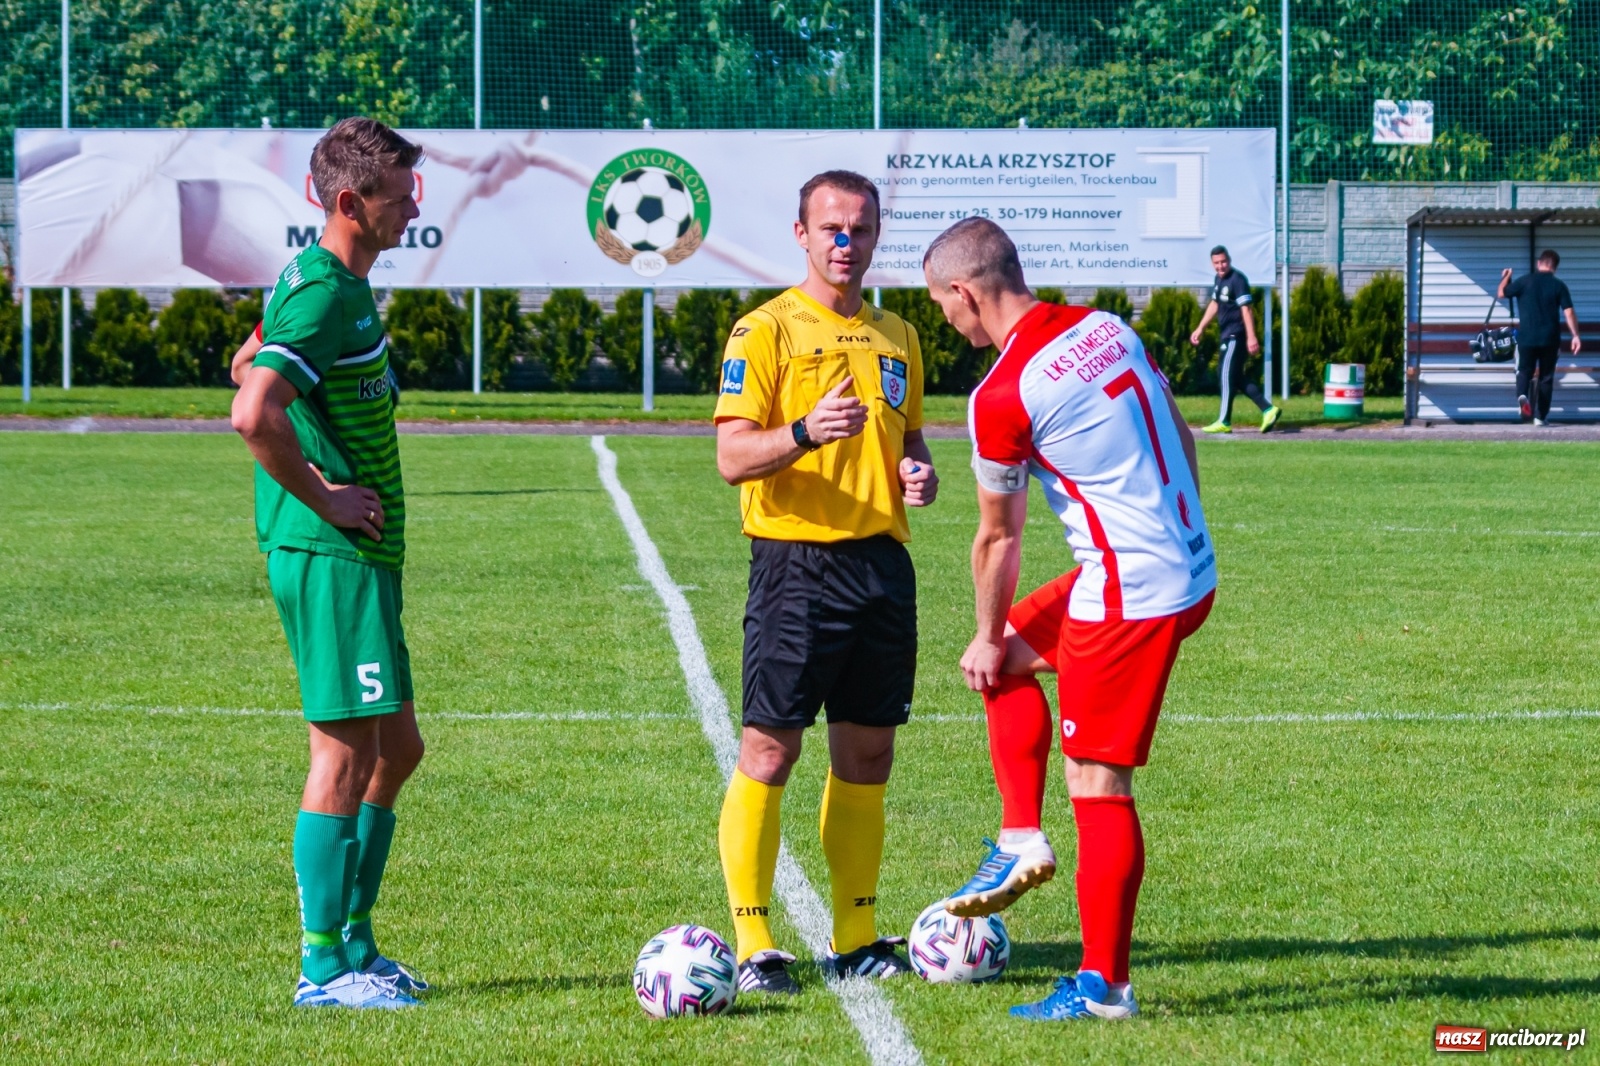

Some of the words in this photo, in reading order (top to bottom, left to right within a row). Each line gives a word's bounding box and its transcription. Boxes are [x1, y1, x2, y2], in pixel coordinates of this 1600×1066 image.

[886, 153, 993, 169] KRZYKAŁA
[998, 153, 1117, 169] KRZYSZTOF
[591, 169, 616, 203] LKS
[894, 177, 917, 186] von
[921, 175, 995, 189] genormten
[998, 174, 1077, 188] Fertigteilen,
[1081, 173, 1157, 186] Trockenbau
[881, 208, 945, 220] Plauener
[998, 207, 1048, 220] 30-179
[1052, 208, 1122, 220] Hannover
[1069, 241, 1129, 252] Markisen
[1050, 258, 1074, 269] Art,
[1078, 257, 1168, 269] Kundendienst
[1043, 355, 1075, 382] LKS
[1076, 340, 1129, 383] CZERNICA
[1102, 367, 1170, 486] 7
[356, 662, 384, 703] 5
